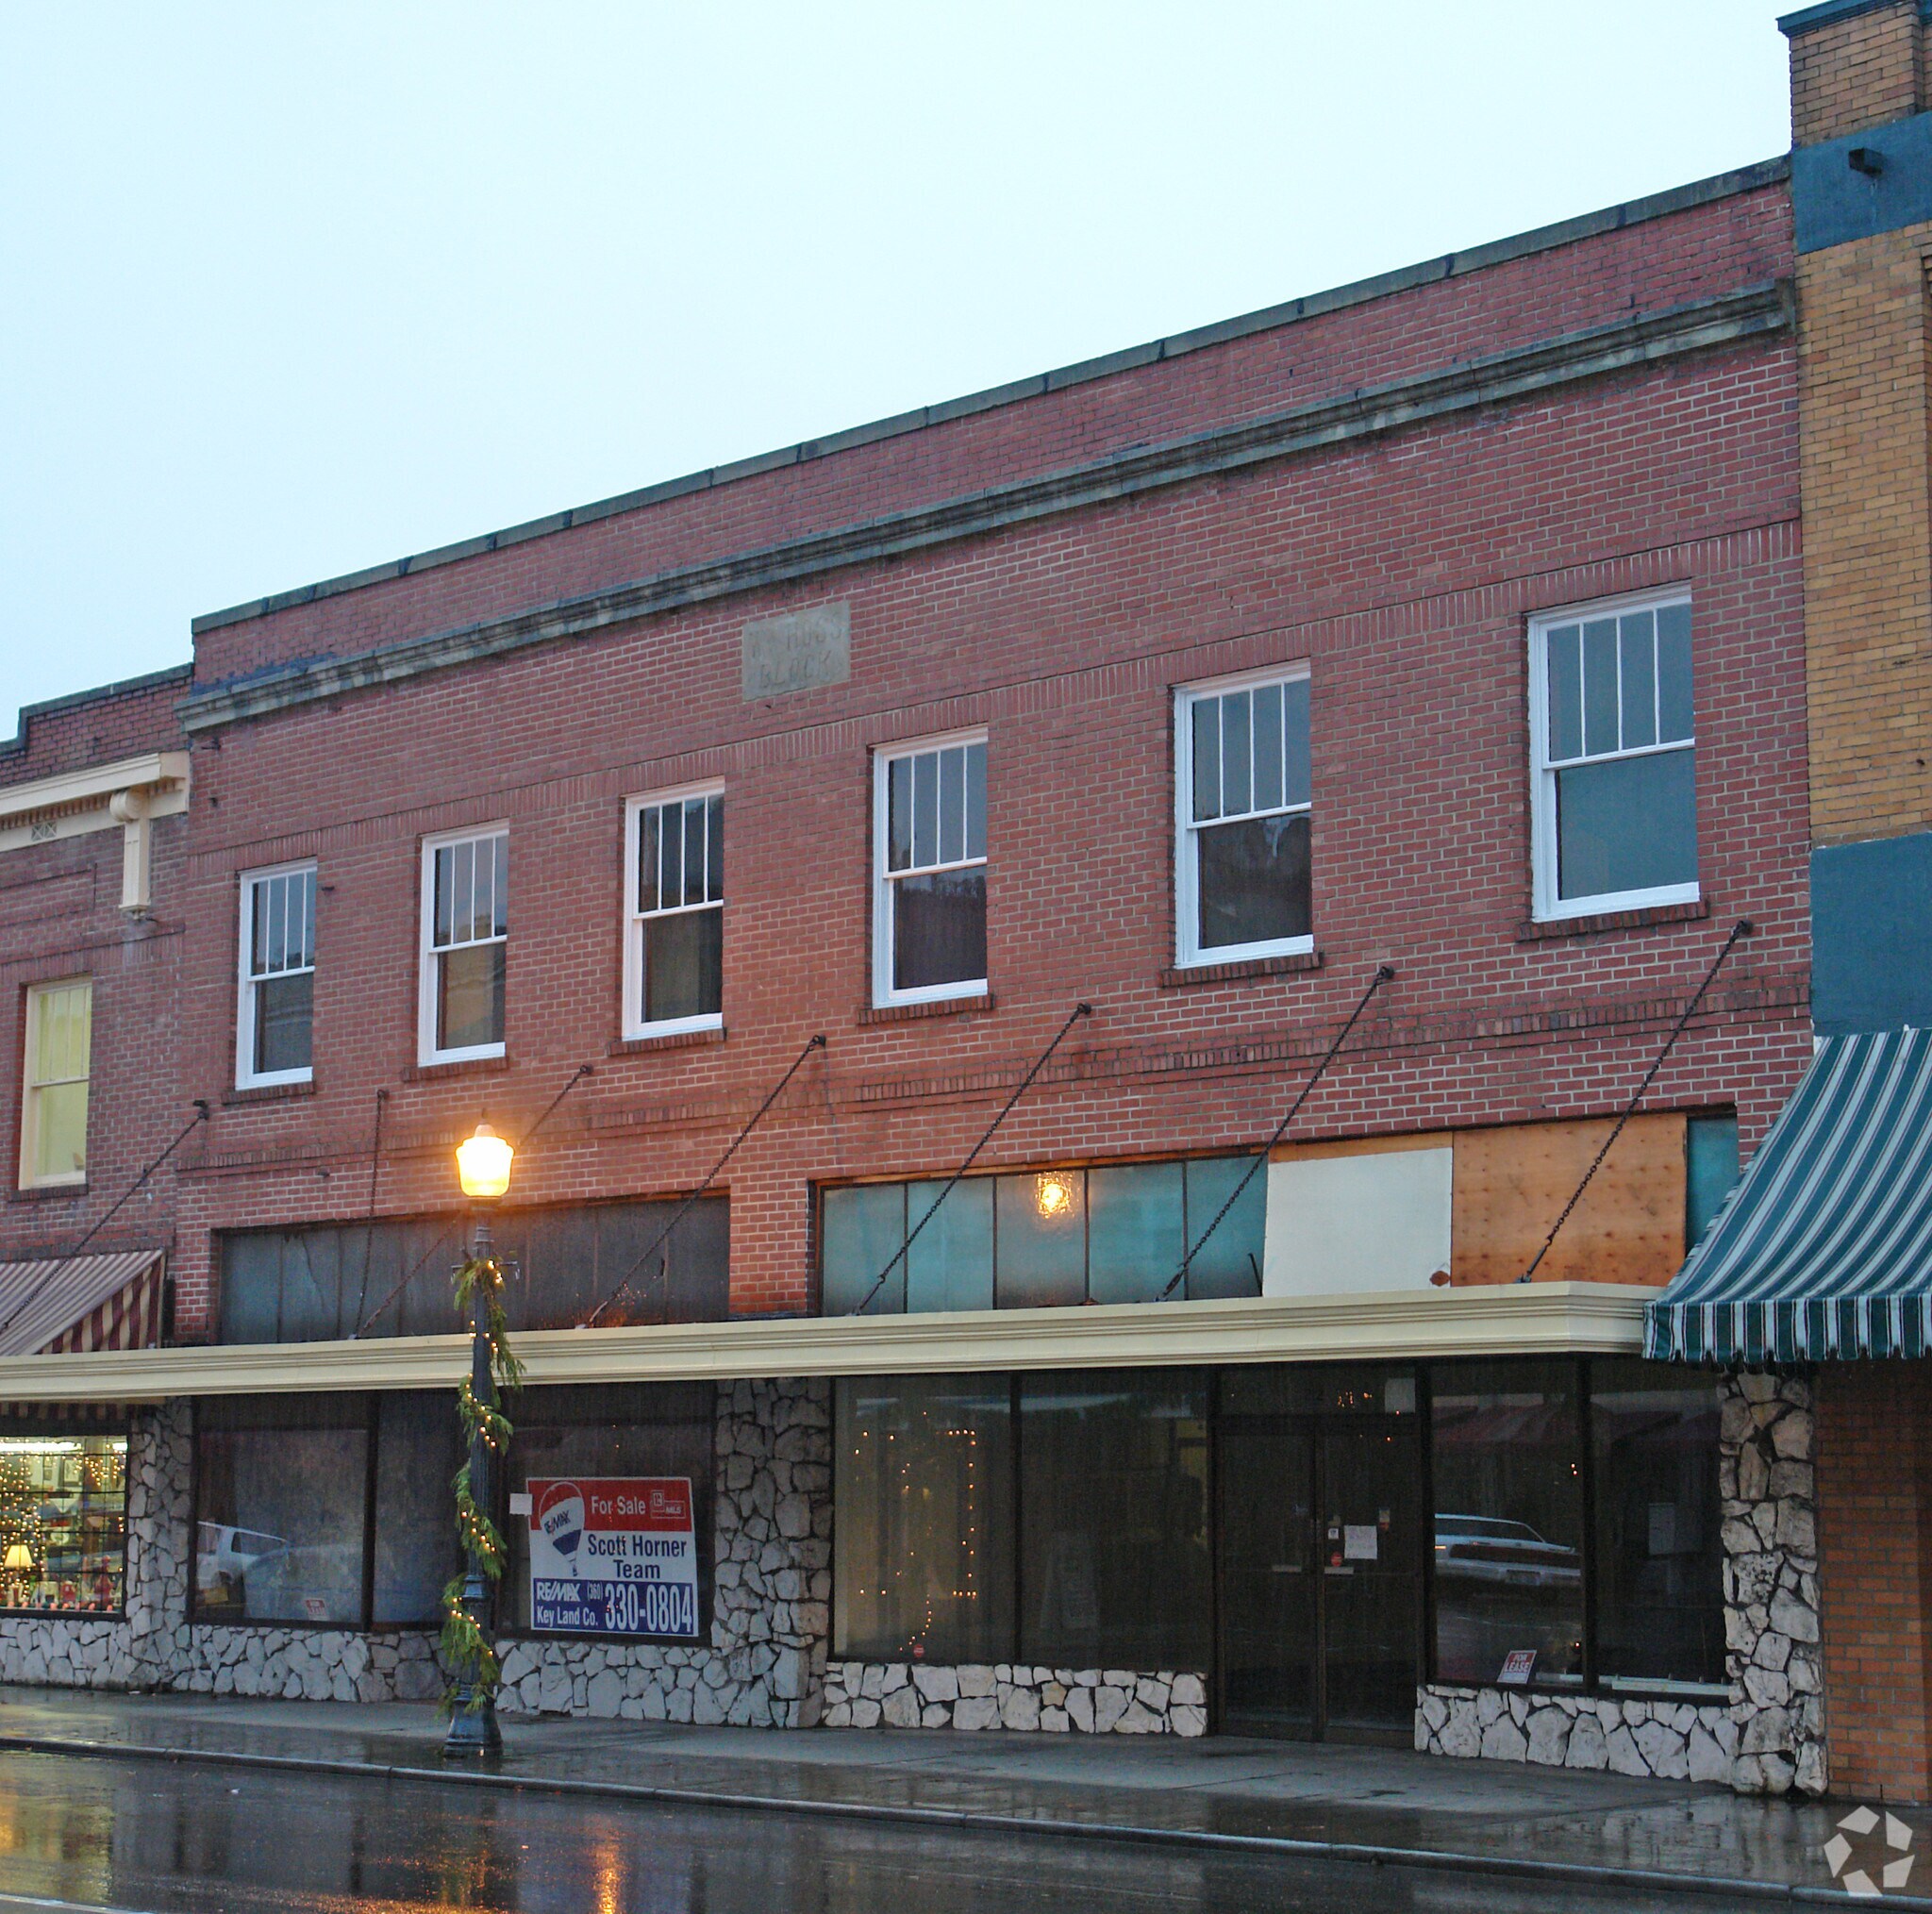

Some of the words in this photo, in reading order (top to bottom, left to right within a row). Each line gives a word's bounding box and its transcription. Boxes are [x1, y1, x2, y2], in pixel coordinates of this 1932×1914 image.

[759, 650, 832, 689] BLOCK
[591, 1496, 613, 1515] For
[617, 1496, 646, 1515] Sale
[588, 1534, 626, 1556] Scott
[633, 1536, 687, 1556] Horner
[613, 1559, 660, 1579] Team
[536, 1581, 581, 1602] RE/MAX
[537, 1606, 555, 1627] Key
[558, 1606, 580, 1624] Land
[583, 1607, 598, 1625] Co.
[587, 1581, 603, 1601] (360)
[605, 1583, 692, 1633] 330-0804
[1505, 1661, 1530, 1673] LEASE
[1513, 1653, 1527, 1662] FOR
